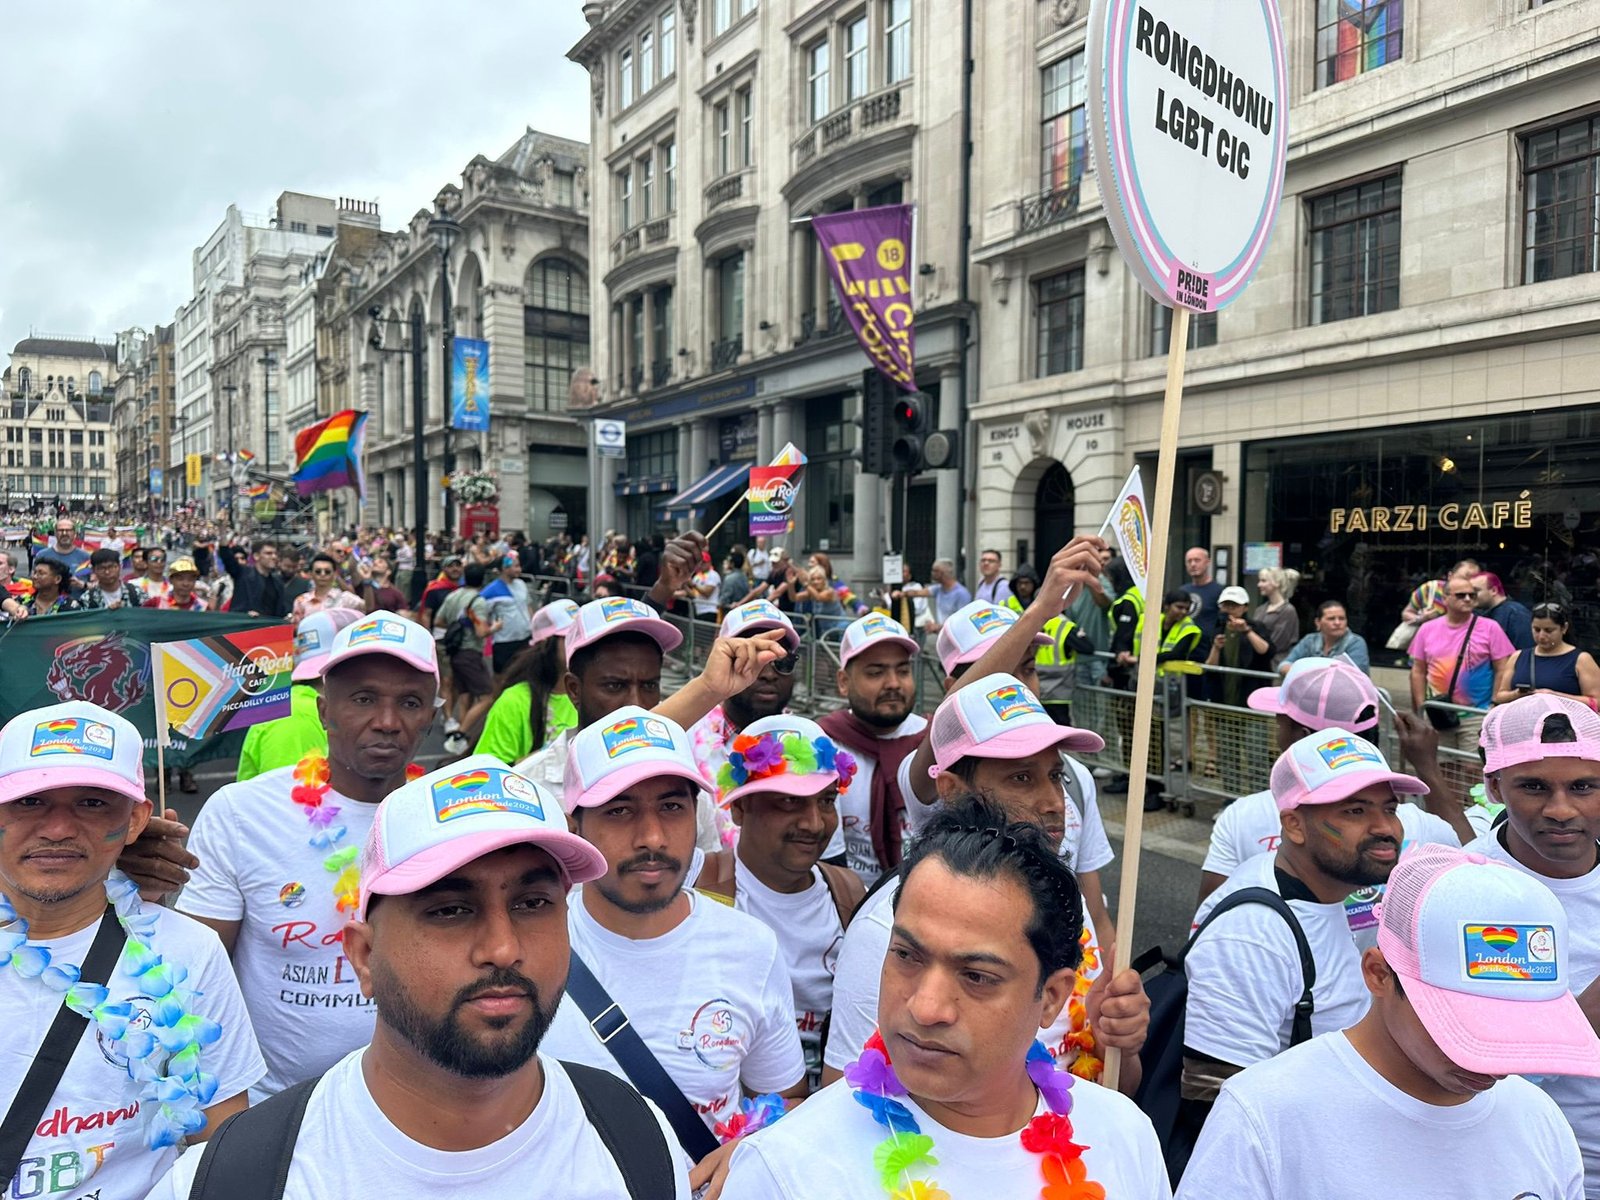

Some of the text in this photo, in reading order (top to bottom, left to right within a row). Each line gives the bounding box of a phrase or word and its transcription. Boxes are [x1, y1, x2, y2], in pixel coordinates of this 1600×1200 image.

[1136, 6, 1273, 136] RONGDHONU
[1155, 87, 1251, 180] LGBT CIC
[884, 248, 900, 262] 18
[1176, 290, 1184, 302] IN
[991, 413, 1104, 440] KINGS HOUSE
[1086, 440, 1098, 450] 10
[1330, 489, 1532, 534] FARZI CAFÉ
[222, 651, 293, 681] Hard Rock
[249, 677, 268, 688] CAFE
[222, 691, 290, 712] PICCADILLY CIRCUS
[40, 736, 81, 746] London
[445, 791, 501, 807] London
[1356, 887, 1373, 896] CAFE
[1475, 952, 1527, 964] London
[282, 964, 329, 985] ASIAN
[1478, 965, 1552, 974] Pride Parade2025
[280, 989, 378, 1009] COMMU
[11, 1142, 115, 1200] GBT
